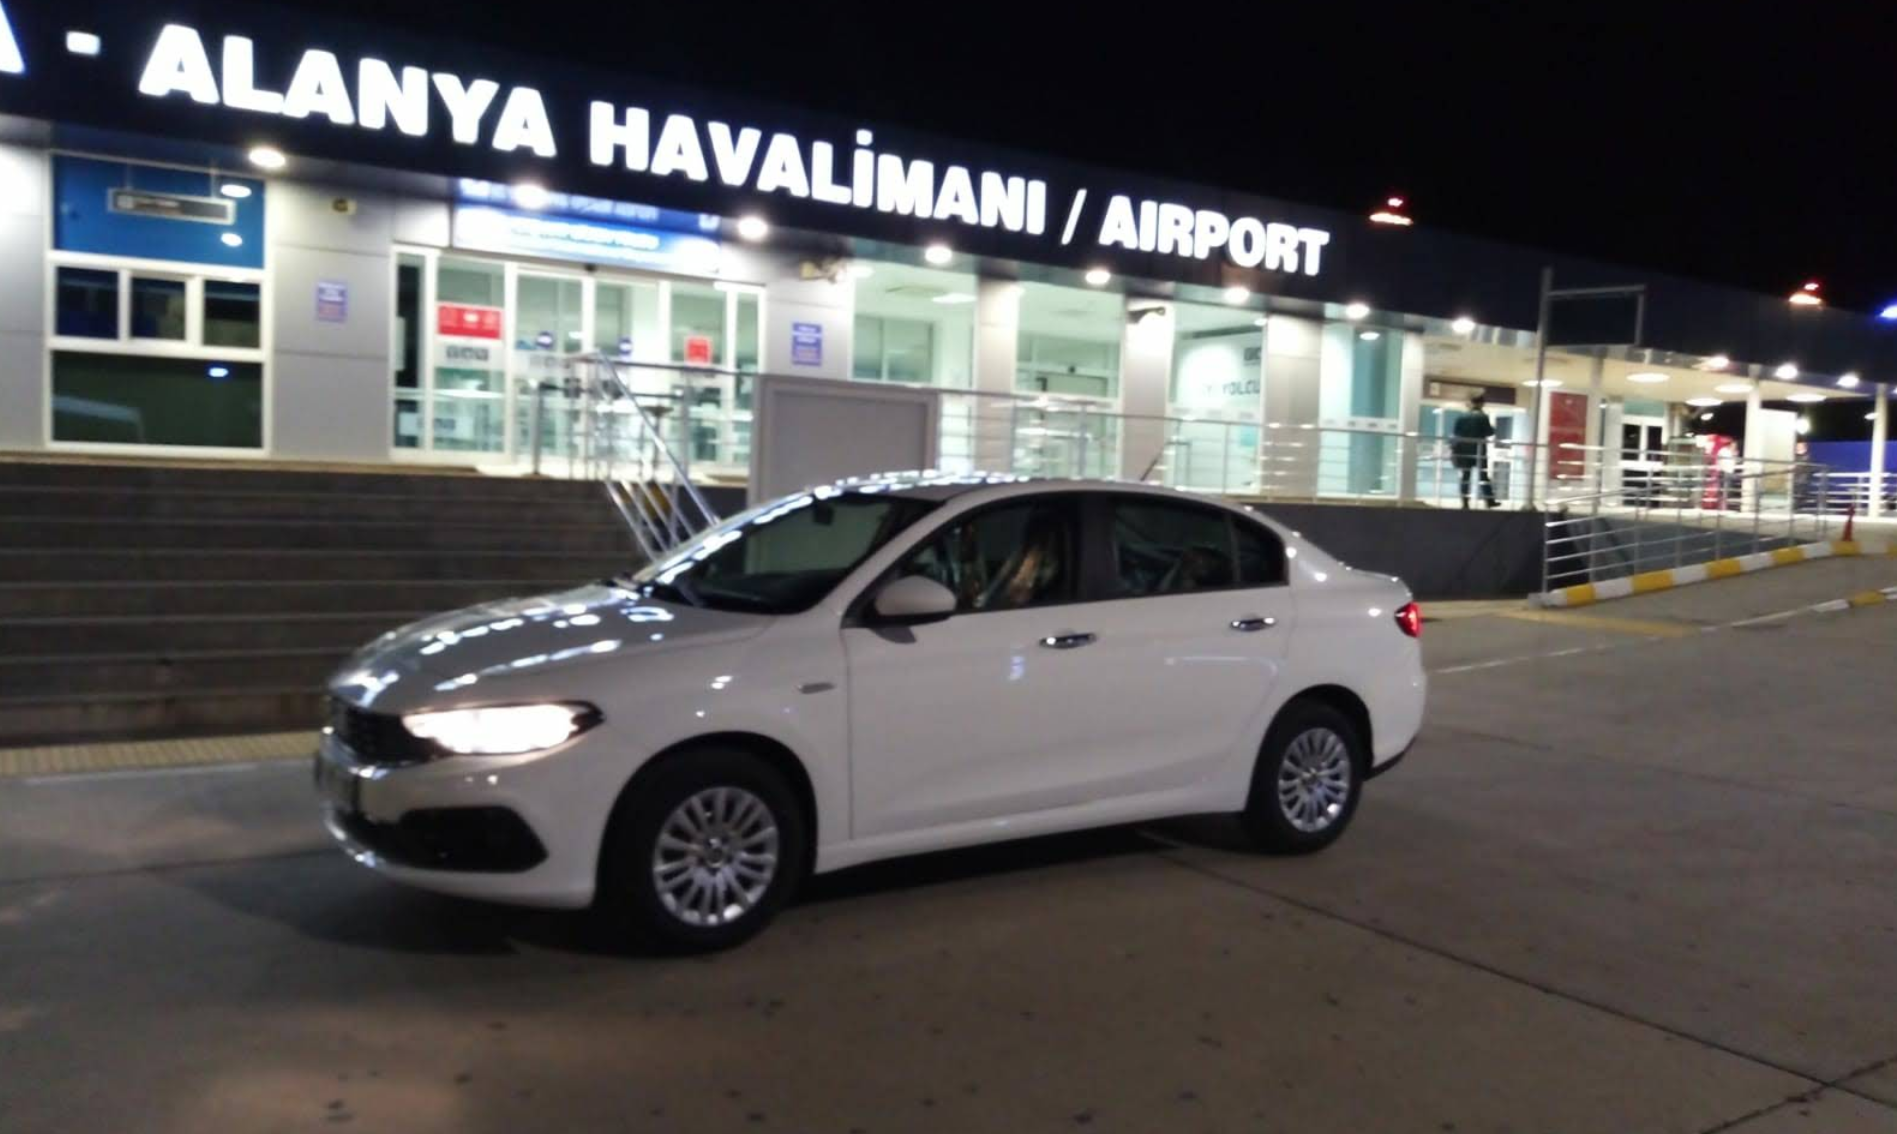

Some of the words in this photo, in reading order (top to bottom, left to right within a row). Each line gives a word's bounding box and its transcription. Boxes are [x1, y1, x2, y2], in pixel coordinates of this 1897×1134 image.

[66, 31, 100, 55] -
[138, 23, 557, 158] ALANYA
[589, 100, 1047, 236] HAVALİMANI
[1060, 188, 1088, 246] /
[1097, 195, 1331, 276] AIRPORT
